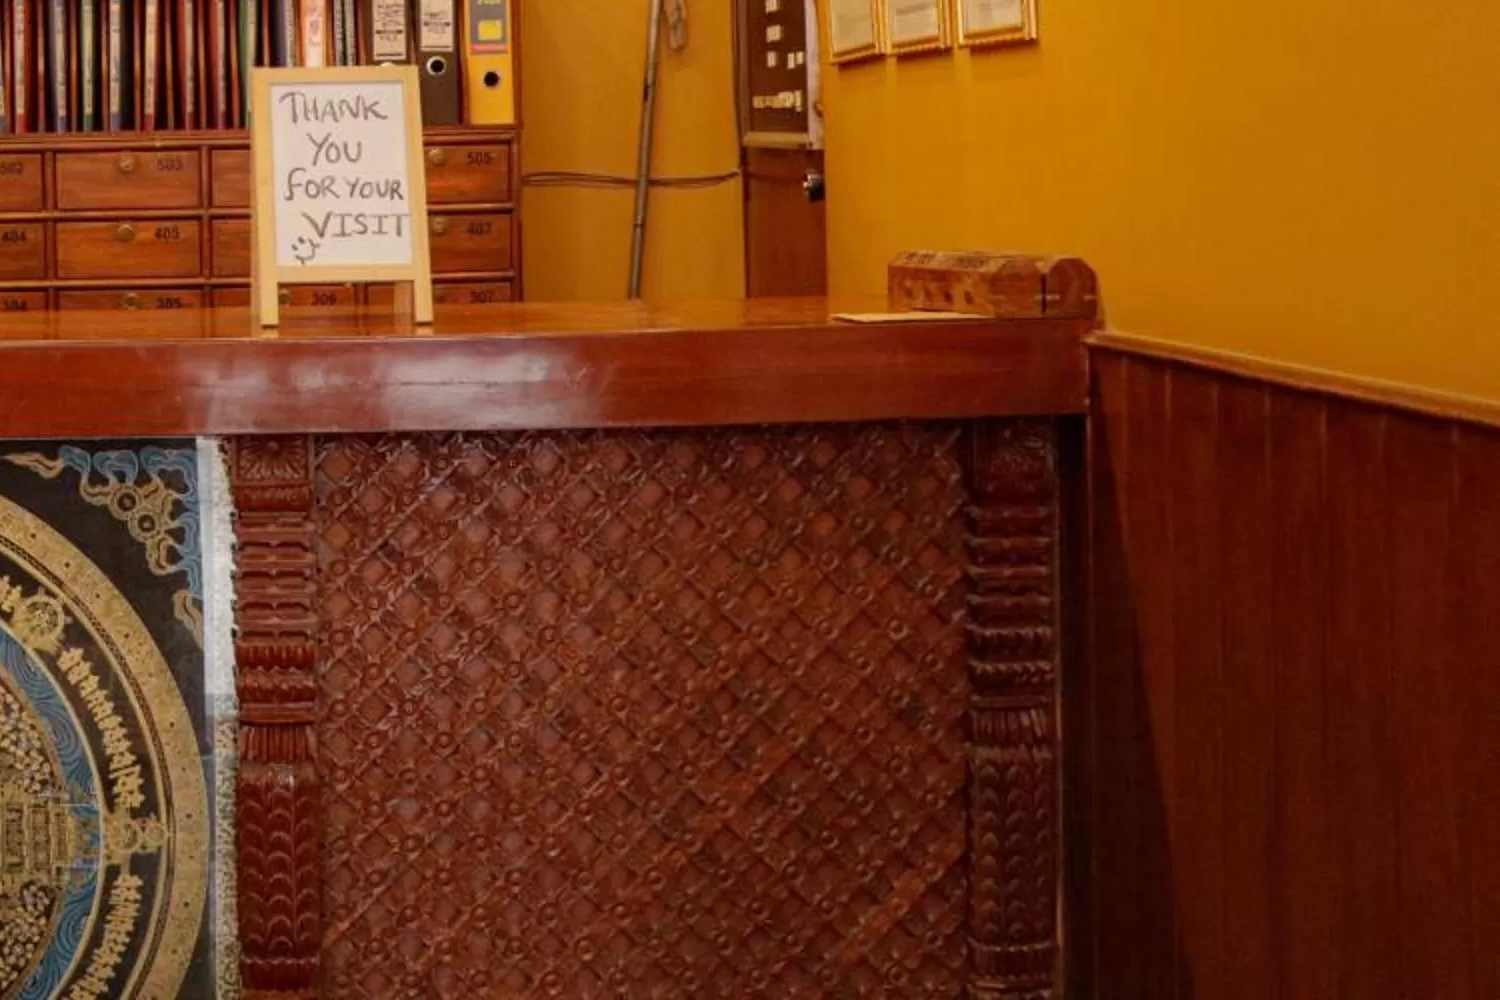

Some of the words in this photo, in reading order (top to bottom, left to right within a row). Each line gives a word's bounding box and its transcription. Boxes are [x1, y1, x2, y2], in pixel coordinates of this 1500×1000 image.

[279, 92, 388, 124] THANK
[306, 132, 363, 166] YOU
[284, 167, 341, 201] FOR
[345, 177, 404, 200] YOUR
[301, 211, 412, 238] VISIT
